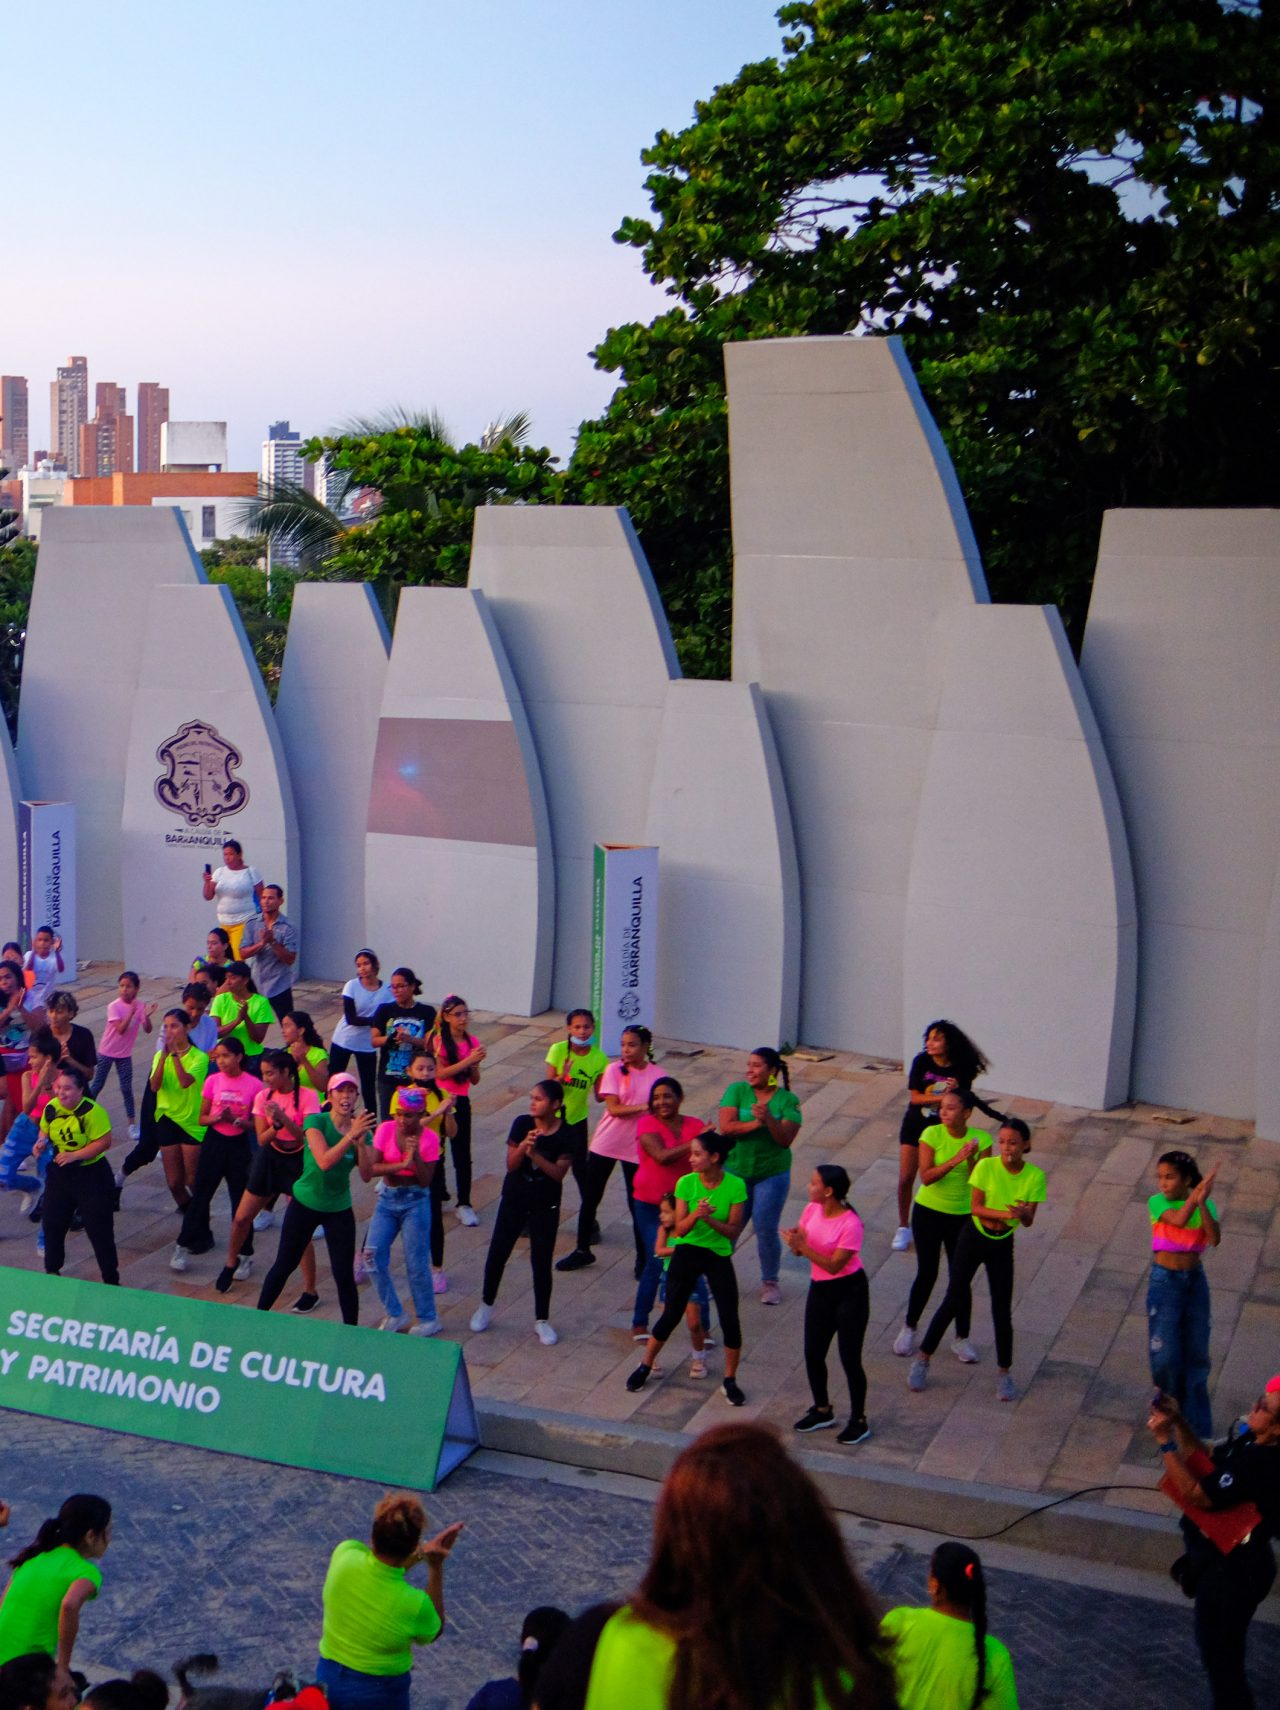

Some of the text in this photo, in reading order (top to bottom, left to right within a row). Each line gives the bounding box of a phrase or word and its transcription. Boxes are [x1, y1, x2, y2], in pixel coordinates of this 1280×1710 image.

[51, 830, 61, 928] BARRANQUILLA
[165, 834, 226, 846] BARRANQUIL
[621, 927, 631, 988] ALCALDÍA DE
[629, 876, 643, 988] BARRANQUILLA
[0, 1348, 220, 1413] Y PATRIMONIO
[7, 1310, 386, 1402] SECRETARÍA DE CULTURA
